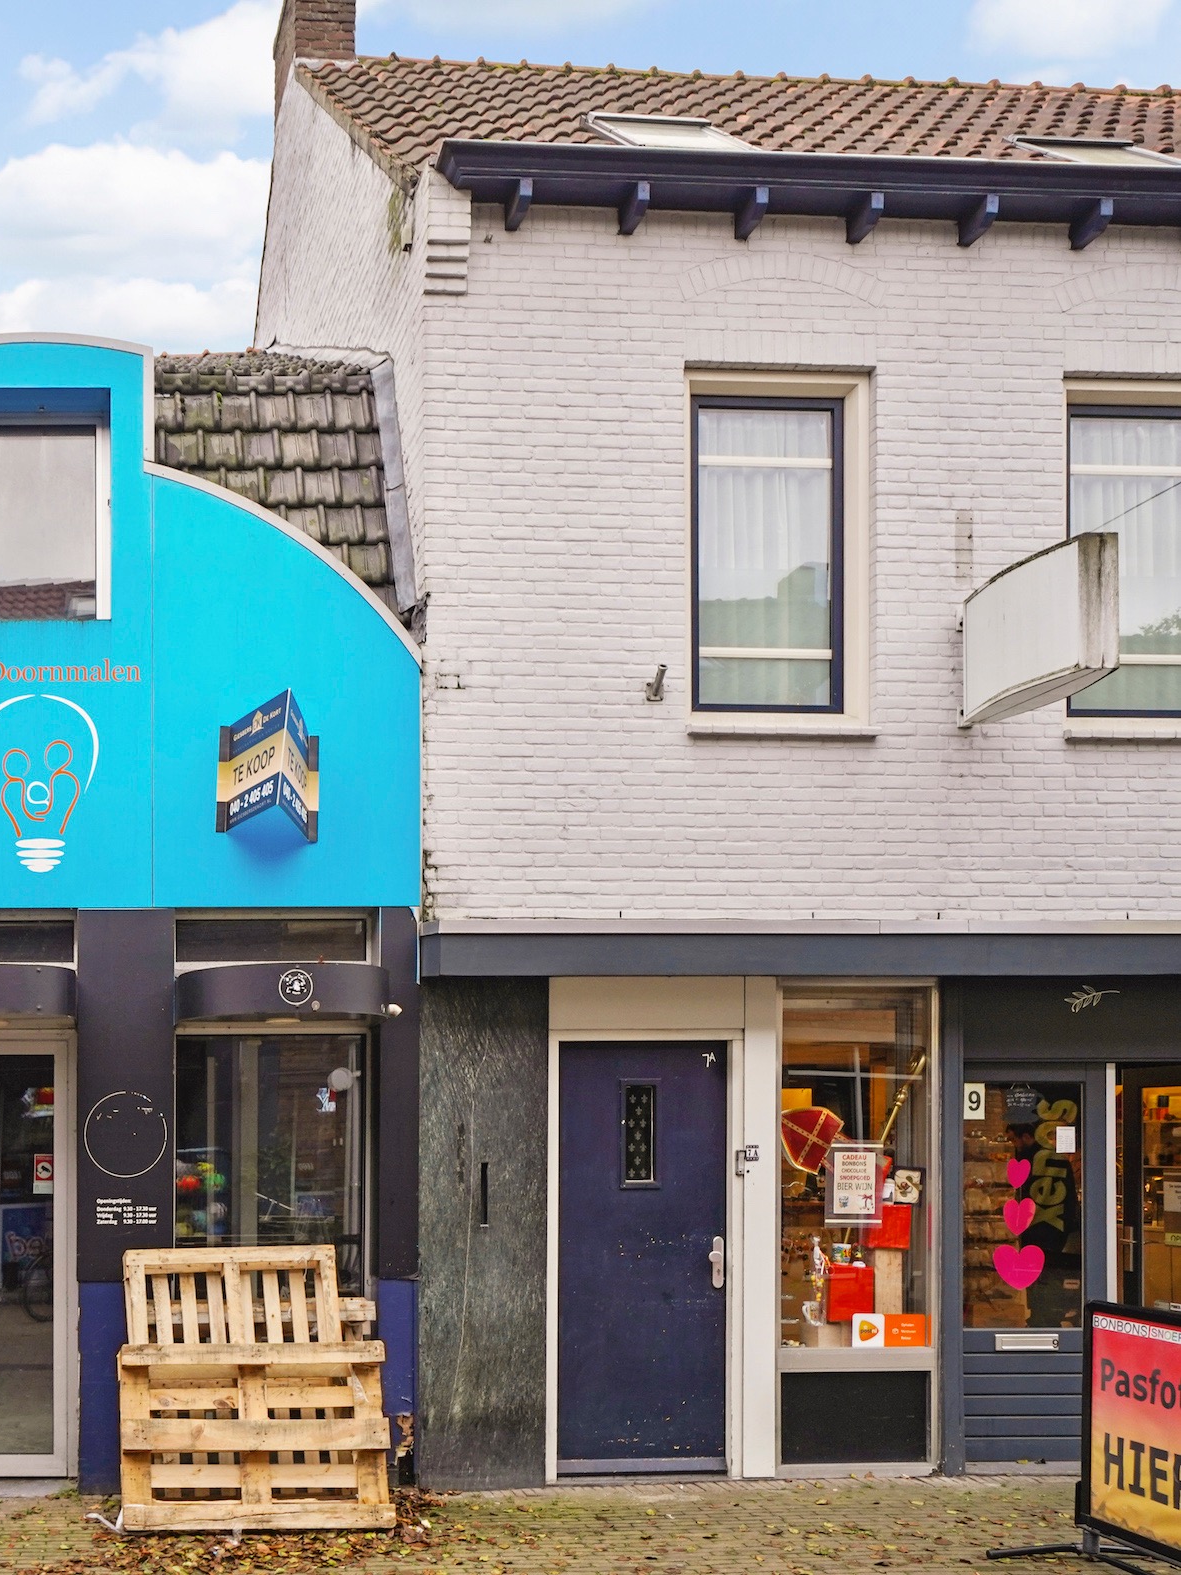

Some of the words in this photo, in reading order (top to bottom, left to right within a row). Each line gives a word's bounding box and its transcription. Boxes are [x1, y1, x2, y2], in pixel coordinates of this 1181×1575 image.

[233, 764, 244, 786] TE
[246, 746, 275, 778] KOOP
[702, 1052, 716, 1068] 7A
[968, 1091, 981, 1111] 9
[1029, 1099, 1078, 1232] xenos
[837, 1183, 853, 1191] BIER
[855, 1182, 873, 1191] WIJN
[1093, 1316, 1148, 1337] BONBONS
[1052, 1339, 1059, 1348] 9
